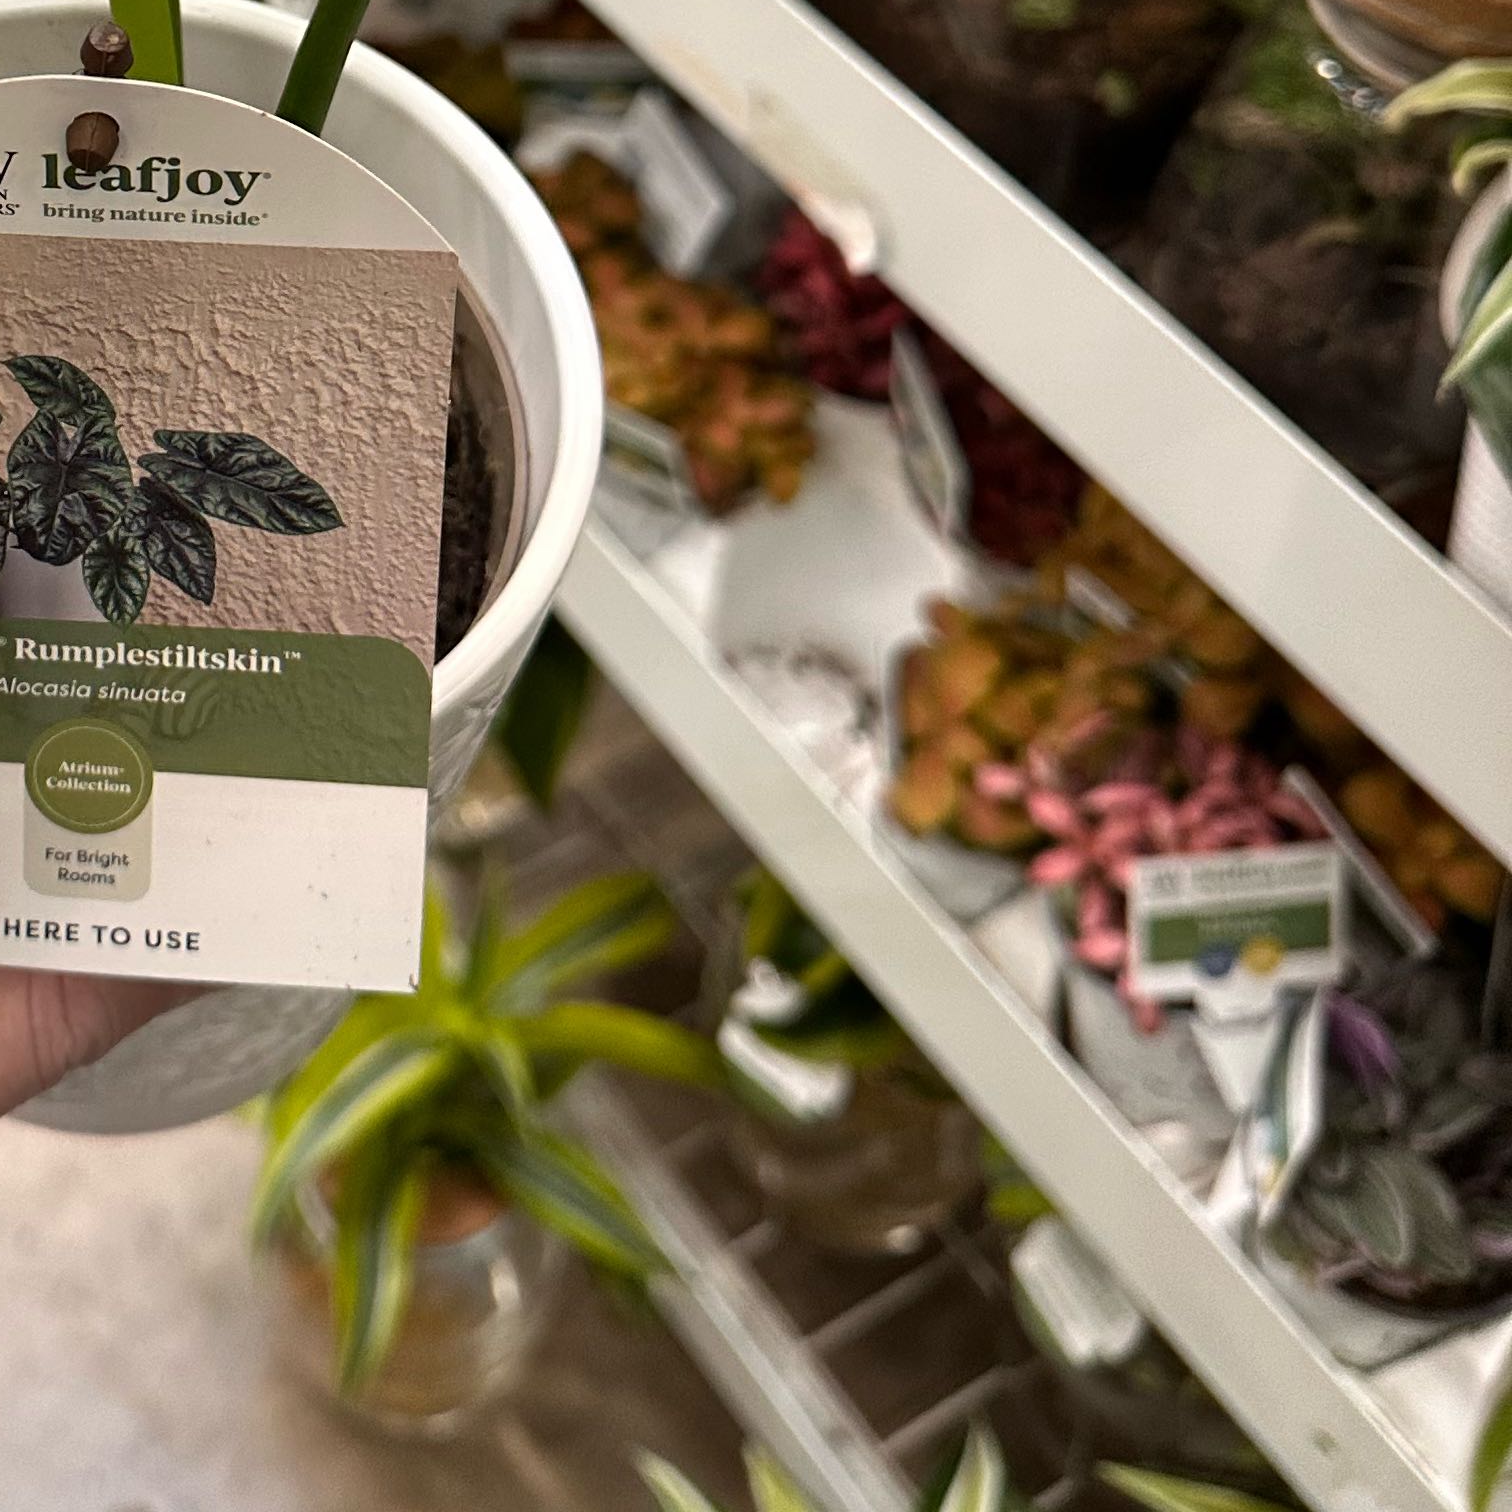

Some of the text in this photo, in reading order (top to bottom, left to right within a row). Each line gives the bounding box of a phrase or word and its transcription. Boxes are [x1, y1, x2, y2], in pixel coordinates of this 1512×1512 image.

[42, 202, 261, 226] bring nature inside
[97, 682, 187, 704] sinuata
[45, 775, 132, 794] Collection
[44, 846, 130, 869] For Bright
[56, 866, 116, 885] Rooms
[91, 924, 132, 945] TO
[144, 928, 201, 951] USE
